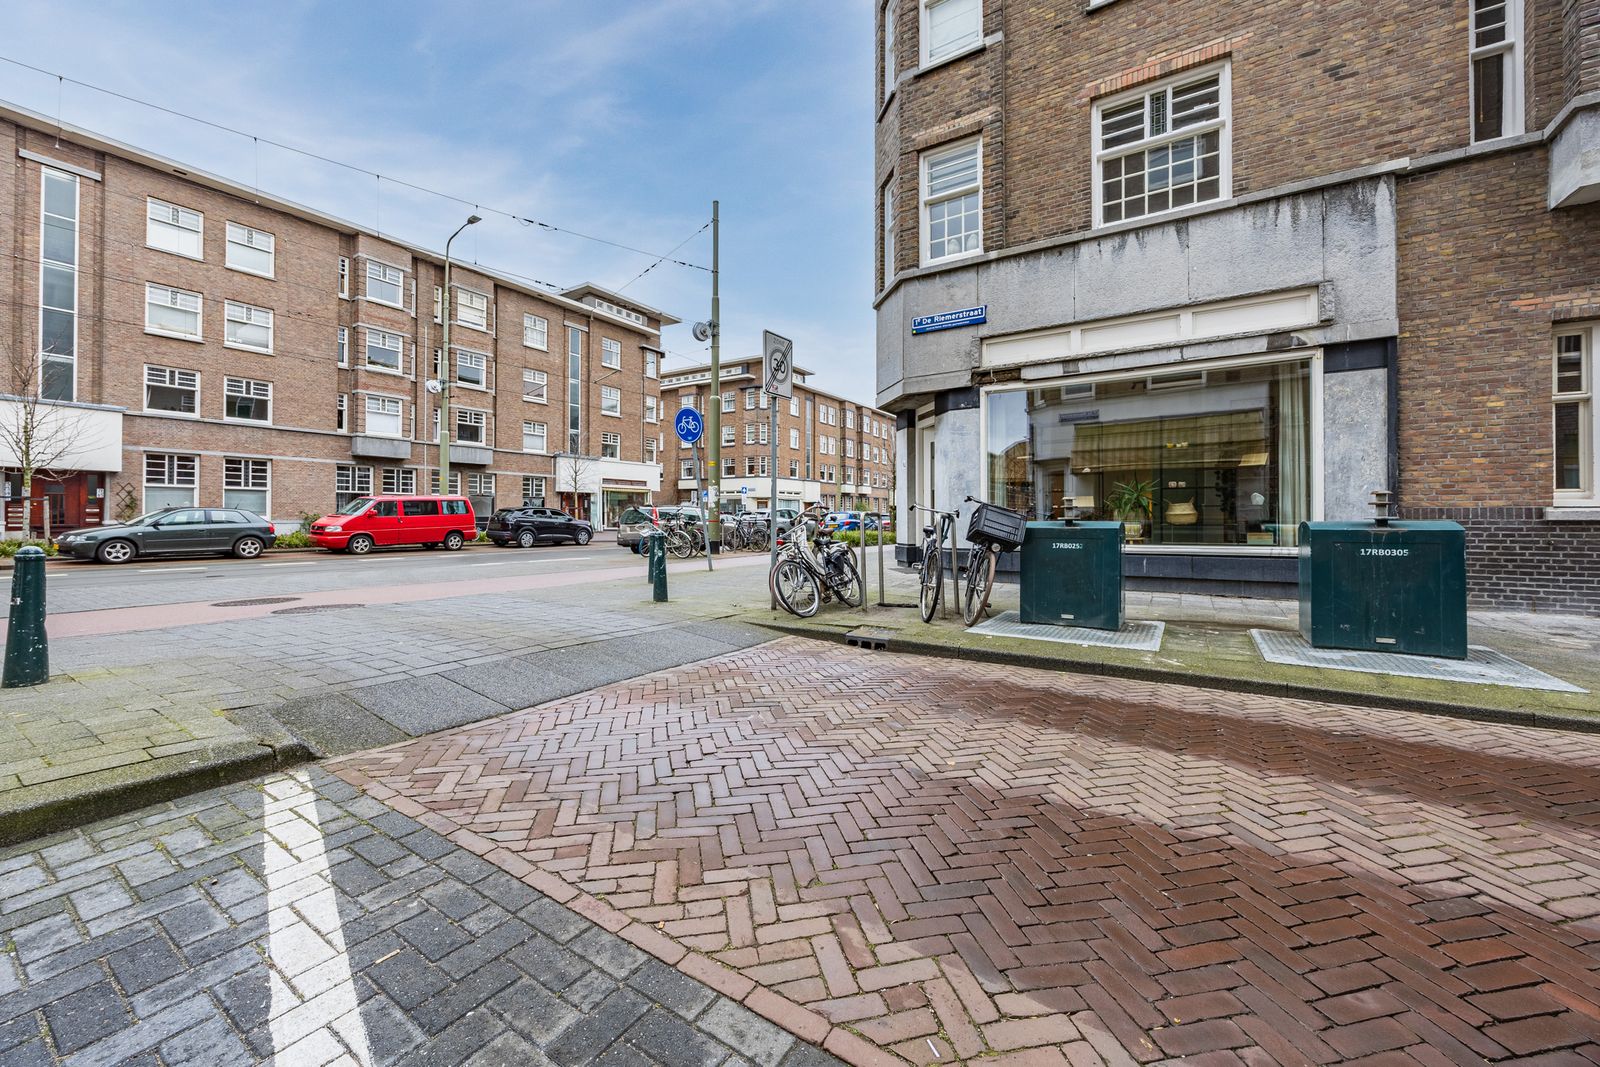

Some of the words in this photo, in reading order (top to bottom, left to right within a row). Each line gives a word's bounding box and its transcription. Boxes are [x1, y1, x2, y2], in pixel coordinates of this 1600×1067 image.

[934, 308, 982, 322] Riemerstraat
[773, 358, 786, 374] 30
[1360, 548, 1409, 556] 17RB0305
